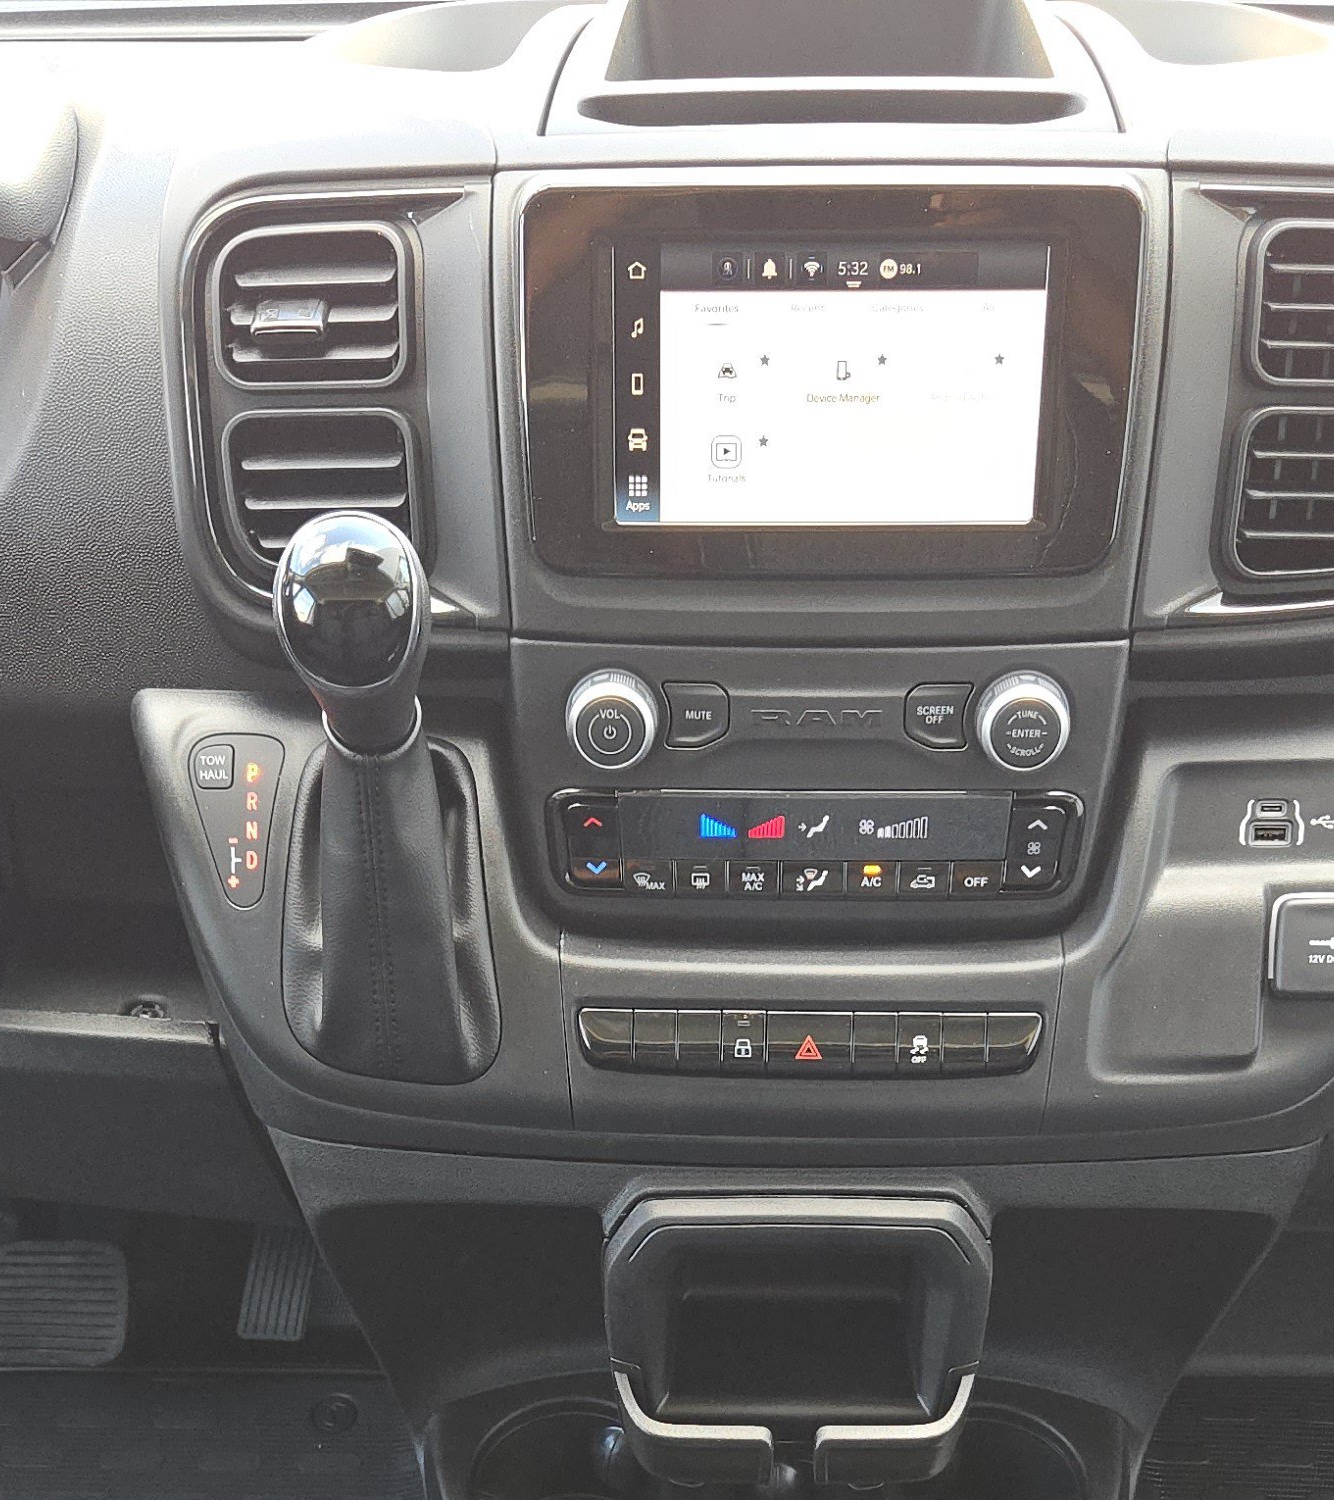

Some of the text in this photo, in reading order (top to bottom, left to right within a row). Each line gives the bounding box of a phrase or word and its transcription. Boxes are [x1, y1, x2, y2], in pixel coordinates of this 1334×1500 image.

[837, 261, 868, 276] 5:32
[900, 263, 921, 275] 98.1
[719, 394, 737, 403] Trip
[807, 394, 880, 405] Device Manager
[626, 500, 650, 512] Apps
[599, 709, 620, 719] VOL
[685, 710, 712, 720] MUTE
[916, 705, 955, 715] SCREEN
[1017, 709, 1039, 720] TUNE
[751, 709, 883, 726] RAM
[925, 716, 944, 725] OFF
[1012, 728, 1042, 738] ENTER
[1010, 745, 1042, 757] SCROLL
[200, 756, 225, 766] TOW
[200, 769, 228, 780] HAUL
[246, 763, 260, 782] P
[246, 792, 258, 810] R
[246, 821, 258, 840] N
[245, 851, 258, 869] D
[741, 872, 765, 882] MAX
[861, 876, 882, 887] A/C
[963, 877, 988, 887] OFF
[646, 881, 666, 890] MAX
[744, 882, 763, 891] A/C
